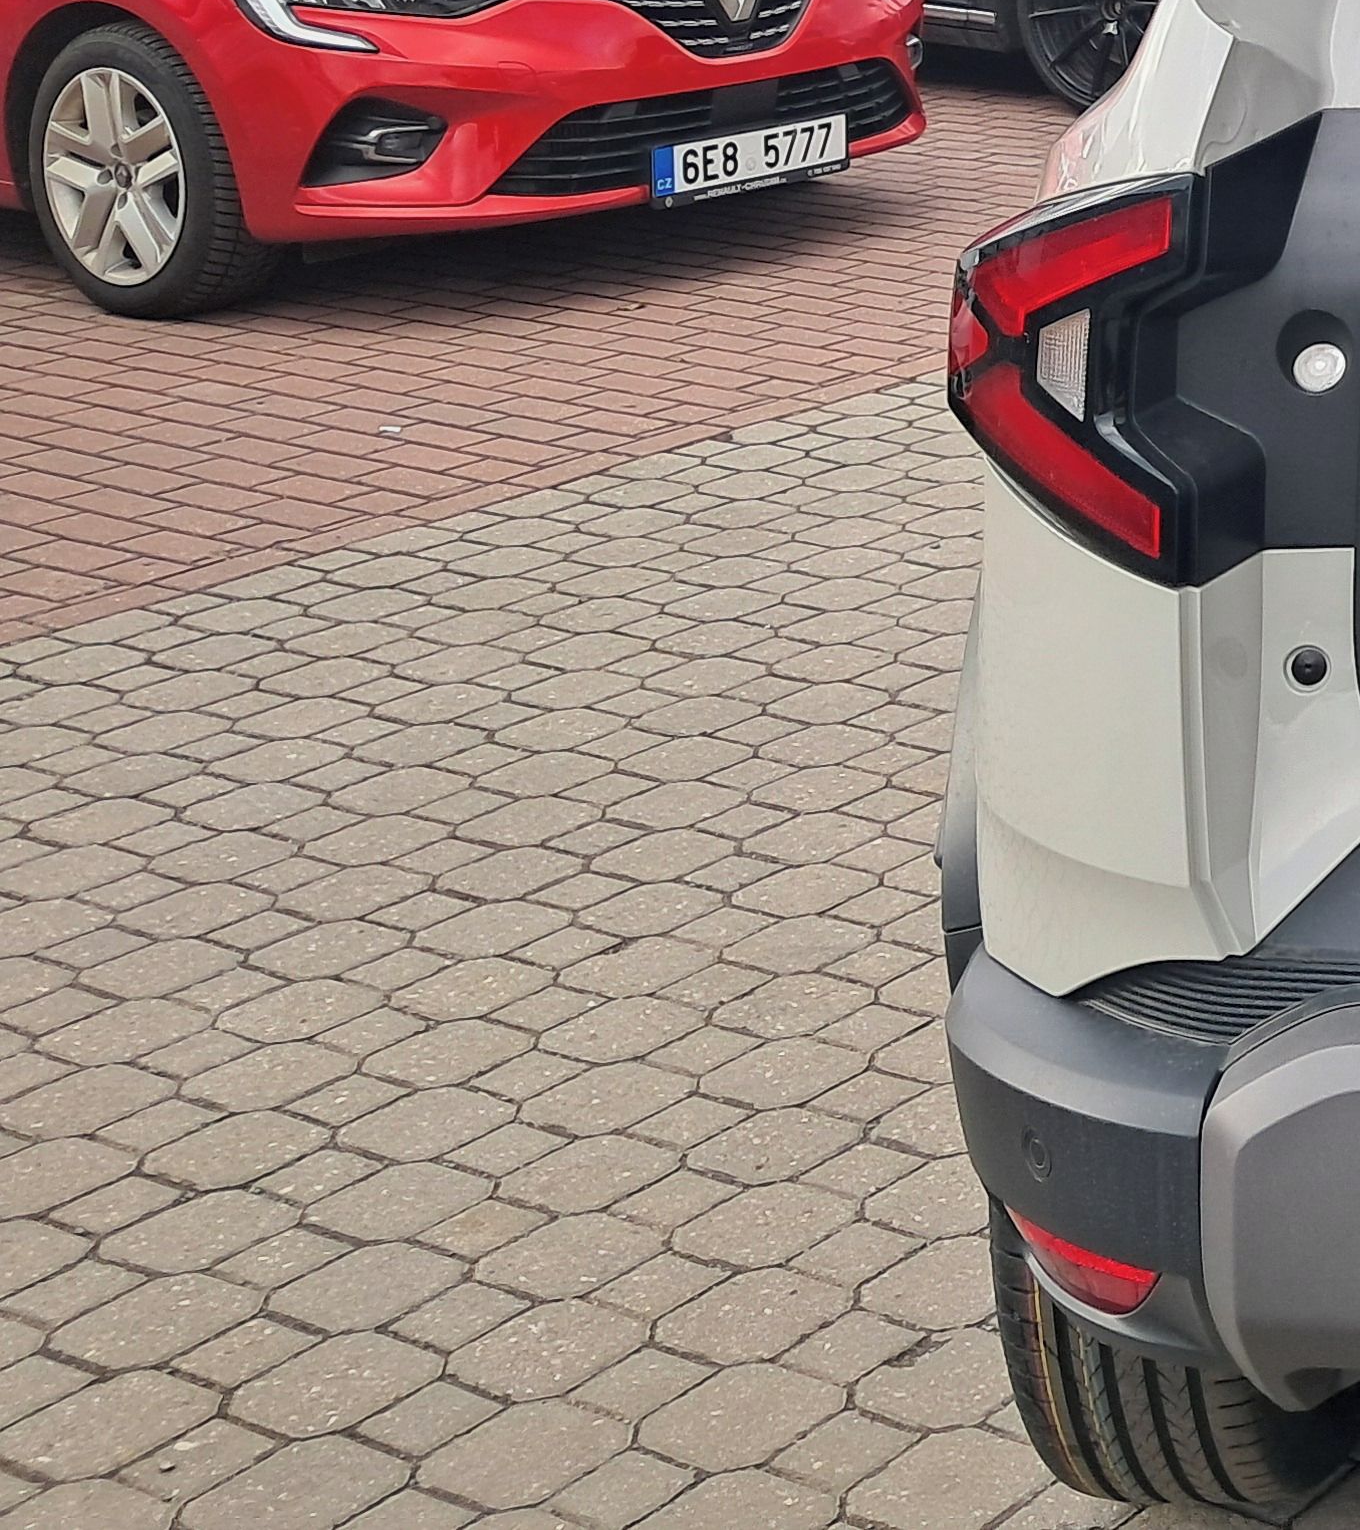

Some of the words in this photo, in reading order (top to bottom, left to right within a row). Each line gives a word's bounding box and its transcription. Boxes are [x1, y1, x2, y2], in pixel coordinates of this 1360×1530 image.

[682, 141, 739, 185] 6E8
[763, 122, 833, 169] 5777
[656, 177, 673, 191] CZ
